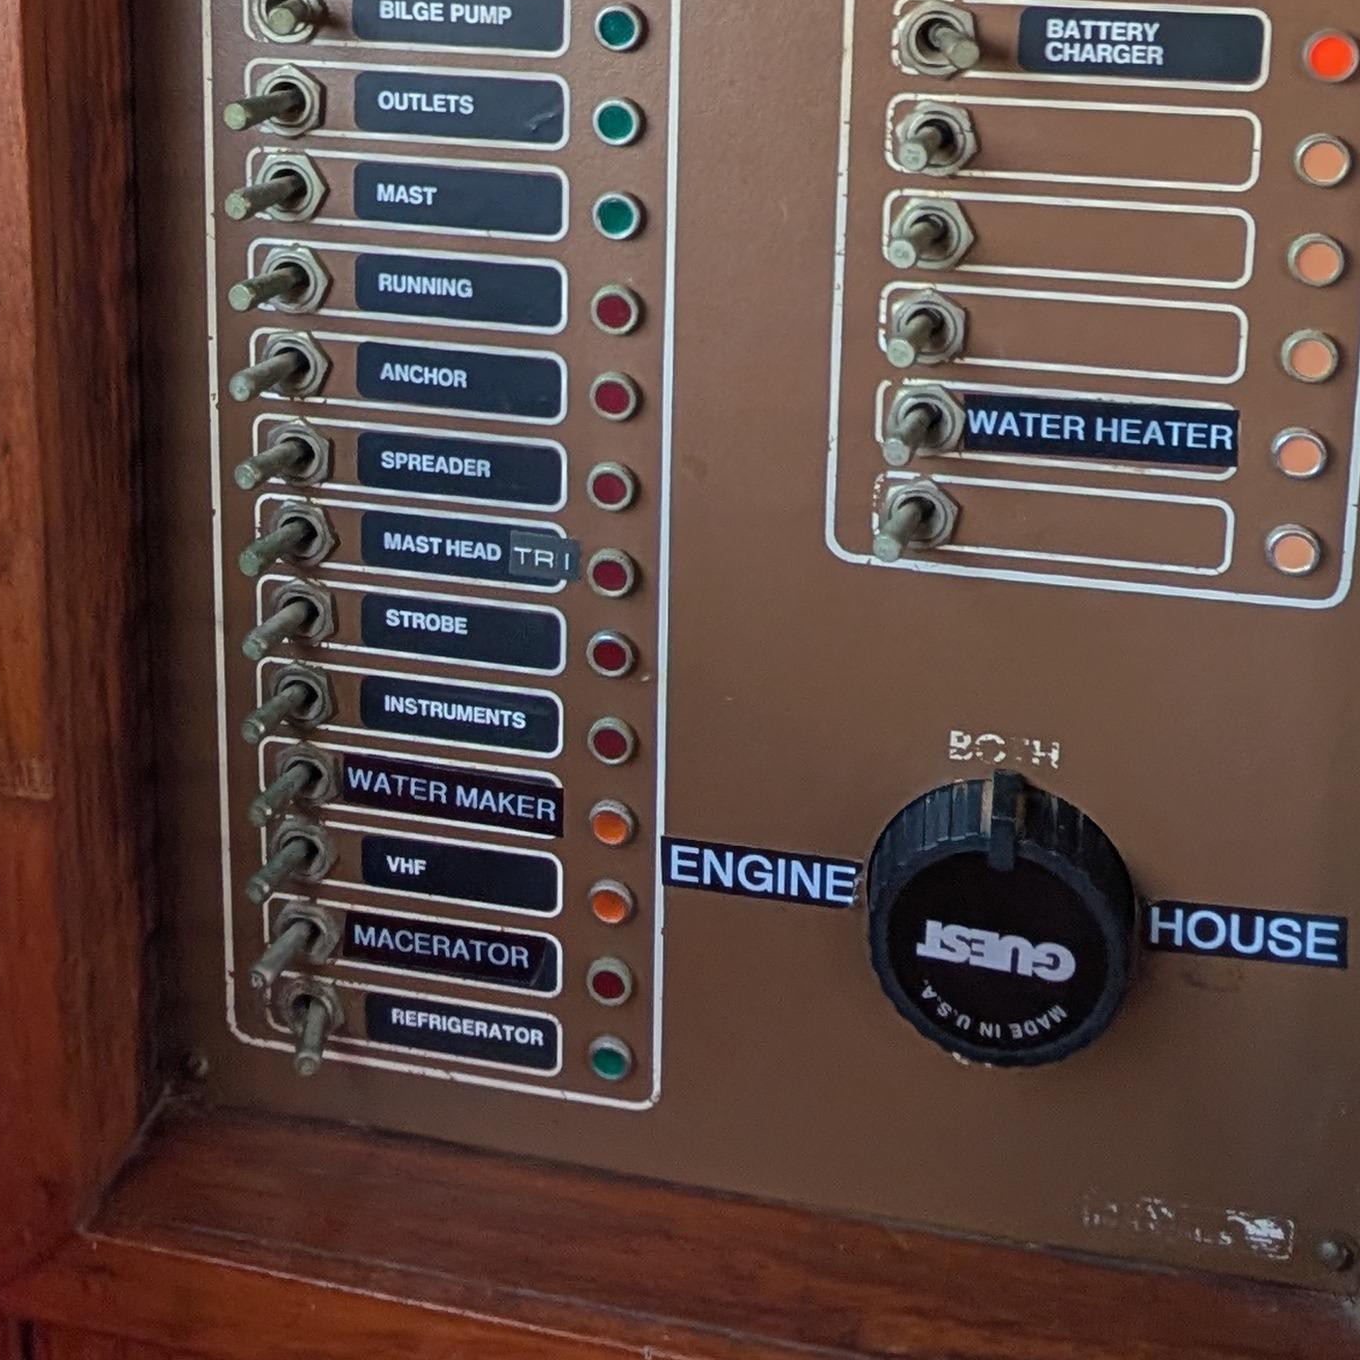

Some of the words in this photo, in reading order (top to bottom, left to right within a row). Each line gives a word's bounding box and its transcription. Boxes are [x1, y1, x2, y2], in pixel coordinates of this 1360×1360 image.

[379, 0, 445, 22] BILGE
[450, 3, 512, 25] PUMP
[1045, 19, 1160, 42] BATTERY
[1045, 42, 1164, 66] CHARGER
[378, 91, 474, 115] OUTLETS
[377, 183, 437, 205] MAST
[378, 273, 473, 298] RUNNING
[380, 363, 468, 389] ANCHOR
[968, 409, 1085, 441] WATER
[1096, 418, 1233, 450] HEATER
[381, 451, 491, 478] SPREADER
[384, 532, 440, 555] MAST
[445, 539, 502, 561] HEAD
[386, 609, 468, 634] STROBE
[384, 694, 526, 729] INSTRUMENTS
[949, 730, 1060, 769] BOH
[347, 767, 447, 804] WATER
[455, 787, 556, 822] MAKER
[386, 855, 427, 876] VHF
[669, 845, 858, 902] ENGINE
[353, 924, 529, 969] MACERATOR
[1150, 906, 1339, 962] HOUSE
[916, 919, 1076, 982] GUEST
[921, 979, 972, 1030] U.S.A.
[391, 1007, 544, 1046] REFRIGERATOR
[979, 1020, 1001, 1039] IN
[1008, 1005, 1068, 1040] MADE
